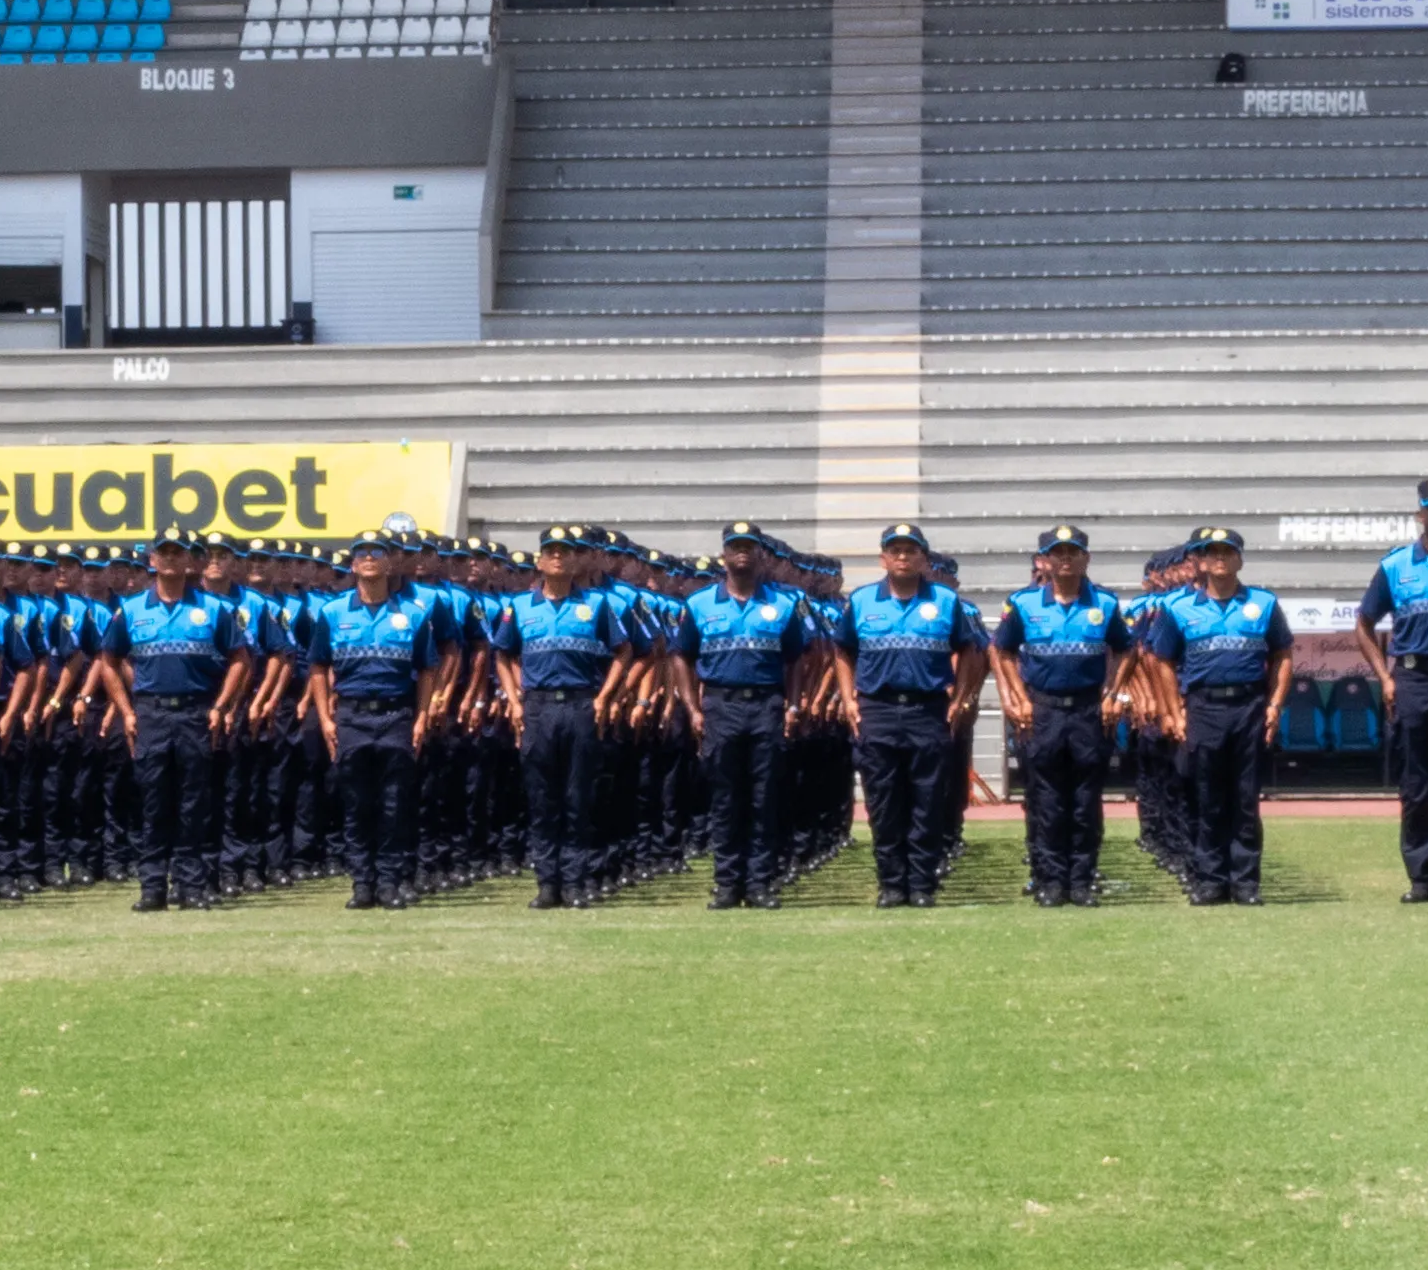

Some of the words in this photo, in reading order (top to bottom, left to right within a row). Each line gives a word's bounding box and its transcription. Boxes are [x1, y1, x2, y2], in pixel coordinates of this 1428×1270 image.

[1325, 2, 1414, 19] sistemas
[141, 67, 215, 91] BLOQUE
[223, 67, 235, 90] 3
[1243, 90, 1368, 115] PREFERENCIA
[113, 356, 171, 382] PALCO
[1279, 515, 1420, 542] PREFERENCIA
